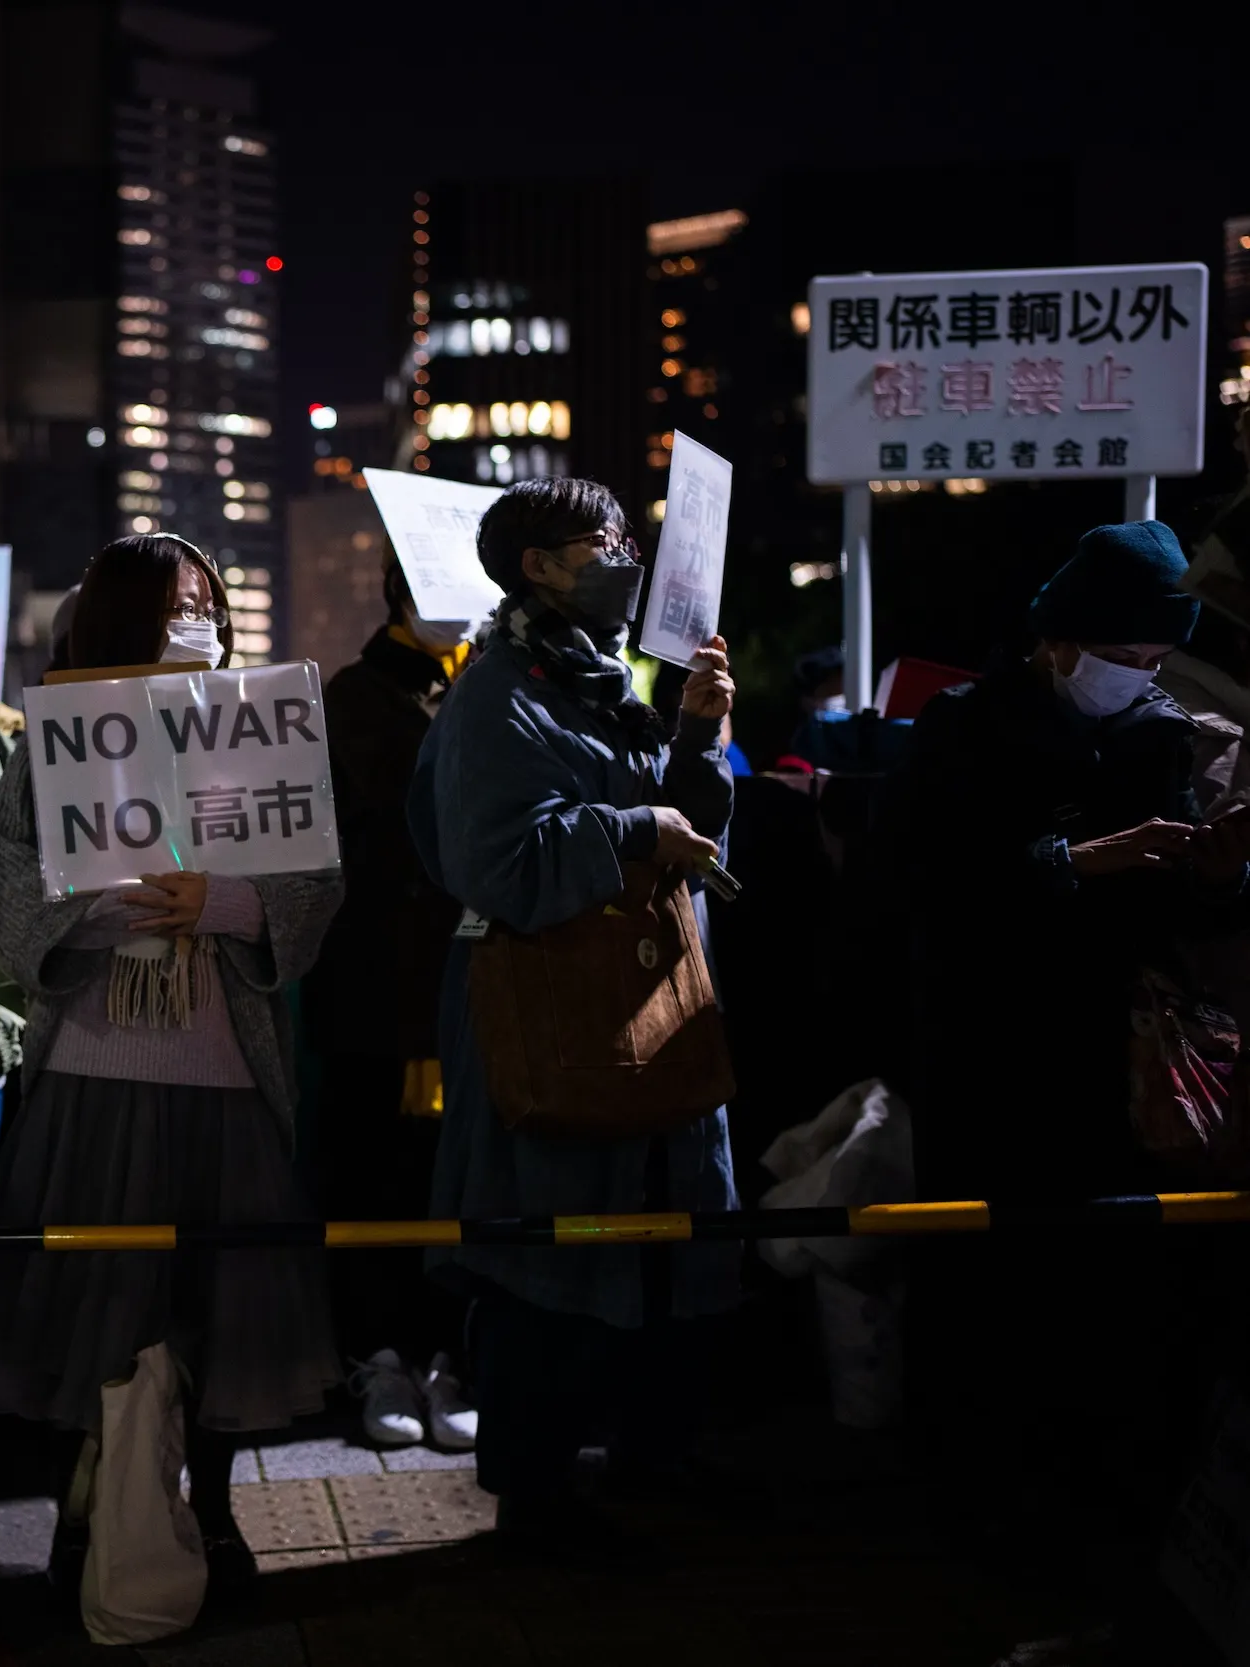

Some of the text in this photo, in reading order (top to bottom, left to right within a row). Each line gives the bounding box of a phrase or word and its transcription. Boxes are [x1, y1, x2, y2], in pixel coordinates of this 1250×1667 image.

[870, 352, 1135, 420] 駐車禁止
[879, 437, 1130, 471] 国会記者会館
[42, 698, 320, 765] NO WAR
[61, 780, 314, 854] NO 高市
